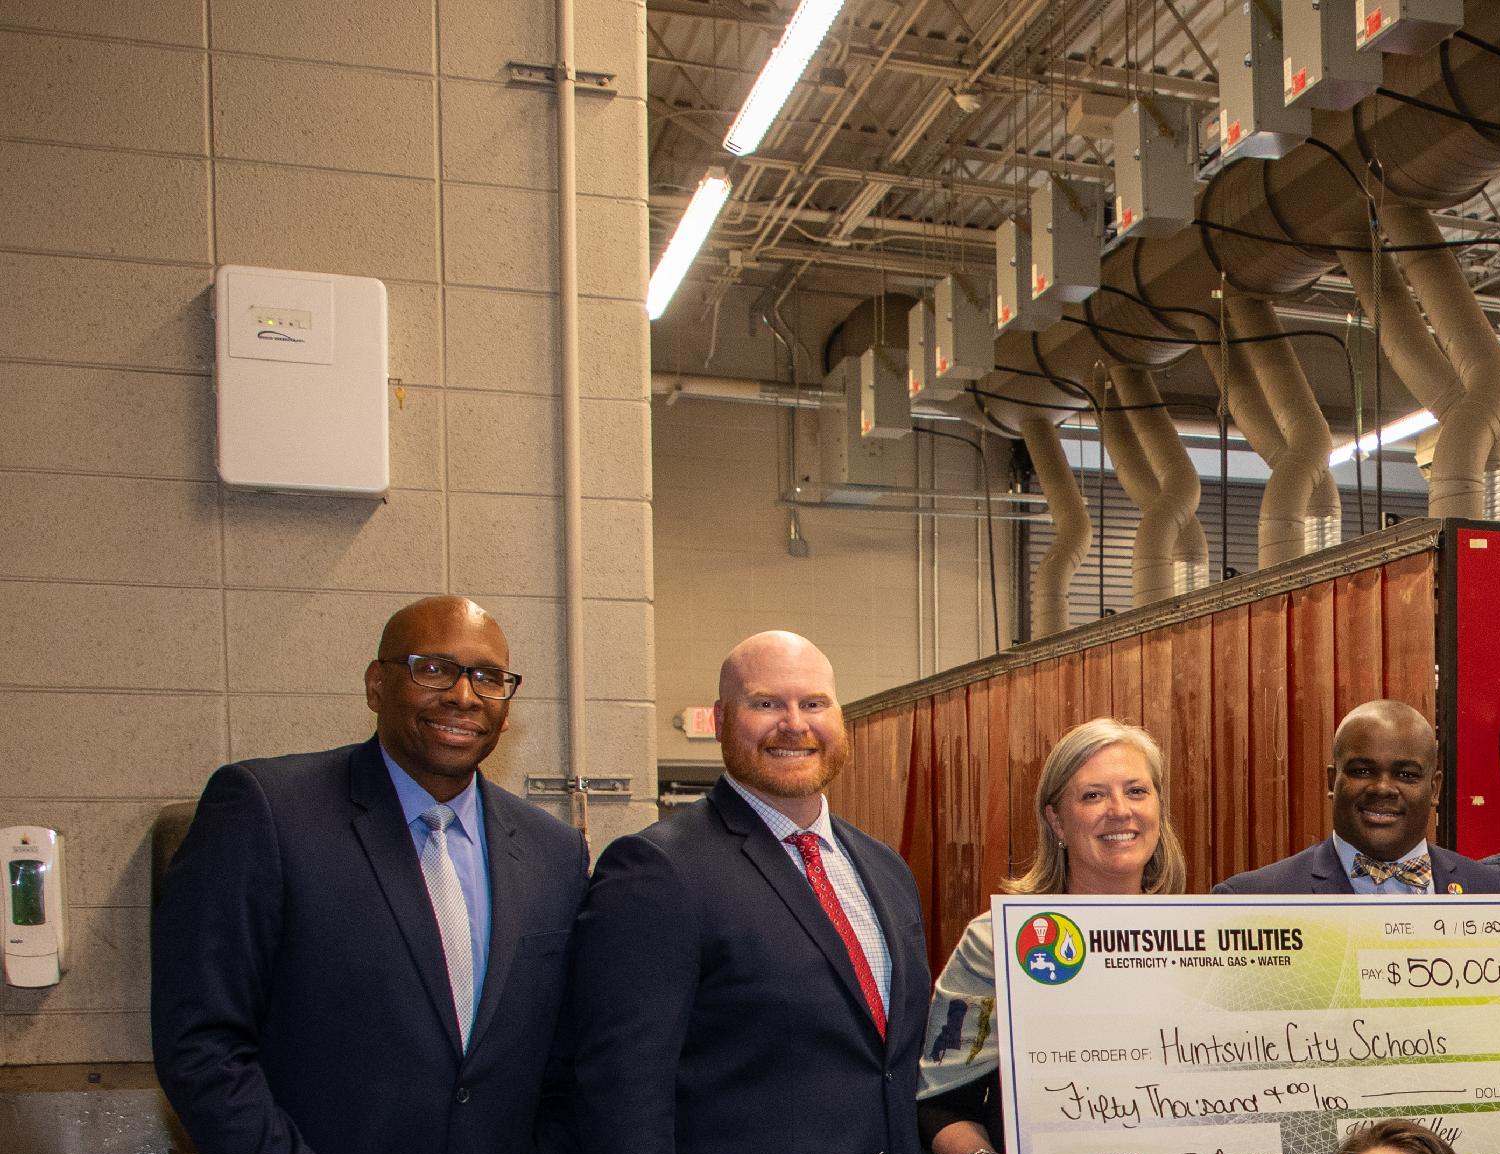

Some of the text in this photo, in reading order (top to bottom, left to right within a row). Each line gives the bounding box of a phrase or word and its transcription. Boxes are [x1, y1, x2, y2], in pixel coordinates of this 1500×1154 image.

[693, 708, 715, 733] EX
[1089, 928, 1304, 952] HUNTSVILLE UTILITIES
[1385, 923, 1415, 935] DATE:
[1104, 956, 1291, 969] ELECTRICITY NATURAL GAS WATER
[1361, 968, 1385, 980] PAY:
[1029, 1051, 1047, 1064] TO
[1051, 1051, 1076, 1063] THE
[1081, 1049, 1127, 1062] ORDER
[1159, 1026, 1279, 1065] Huntsville
[1286, 1022, 1340, 1063] City
[1349, 1019, 1447, 1062] Schools
[1044, 1081, 1141, 1128] Fifty
[1135, 1083, 1258, 1120] Thousand
